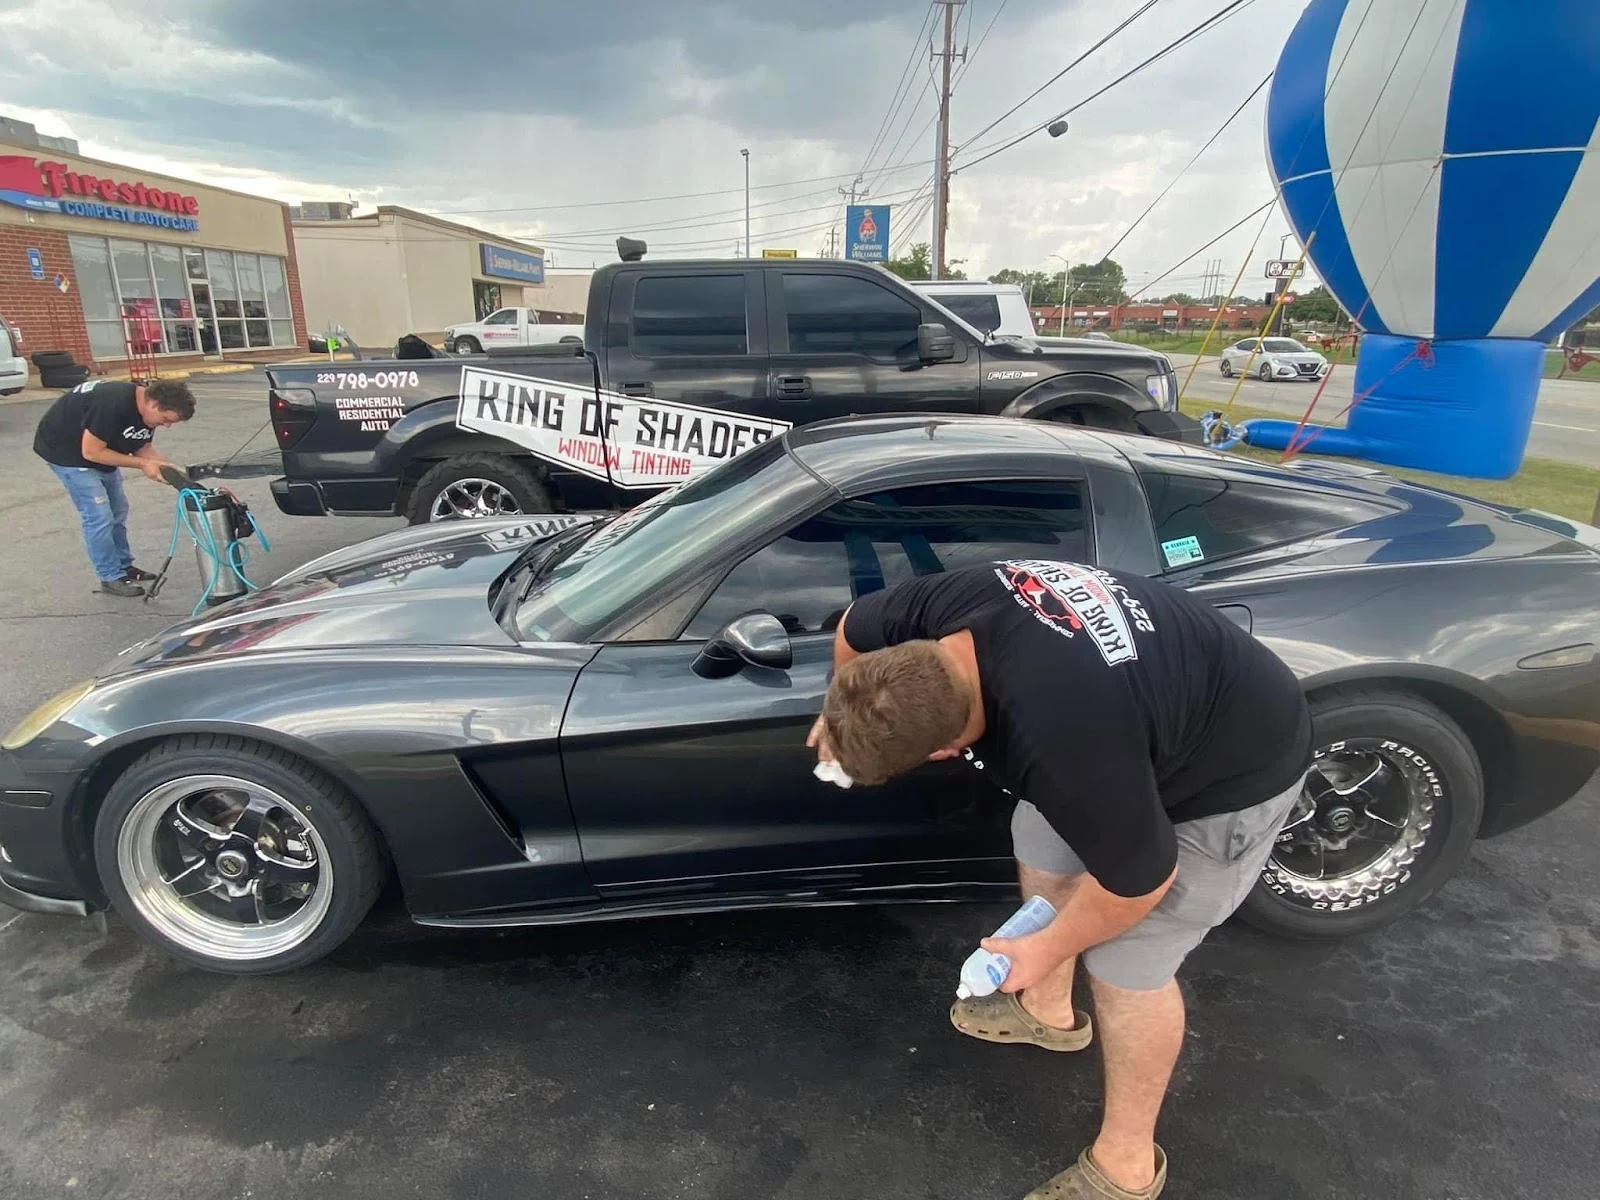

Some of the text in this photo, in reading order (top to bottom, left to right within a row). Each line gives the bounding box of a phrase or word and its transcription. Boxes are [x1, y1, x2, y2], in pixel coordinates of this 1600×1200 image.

[40, 161, 199, 215] Firestone
[139, 212, 169, 229] AUTO
[317, 371, 419, 389] 229 798-0978
[336, 396, 405, 409] COMMERCIAL
[339, 408, 406, 420] RESIDENTIAL
[476, 379, 567, 431] KING
[579, 397, 623, 439] OF
[361, 420, 389, 431] AUTO
[558, 437, 692, 475] WINDOW TINTING
[1059, 585, 1092, 604] OF
[1081, 604, 1126, 654] KING
[1380, 740, 1443, 797] RACING
[1261, 866, 1286, 895] US
